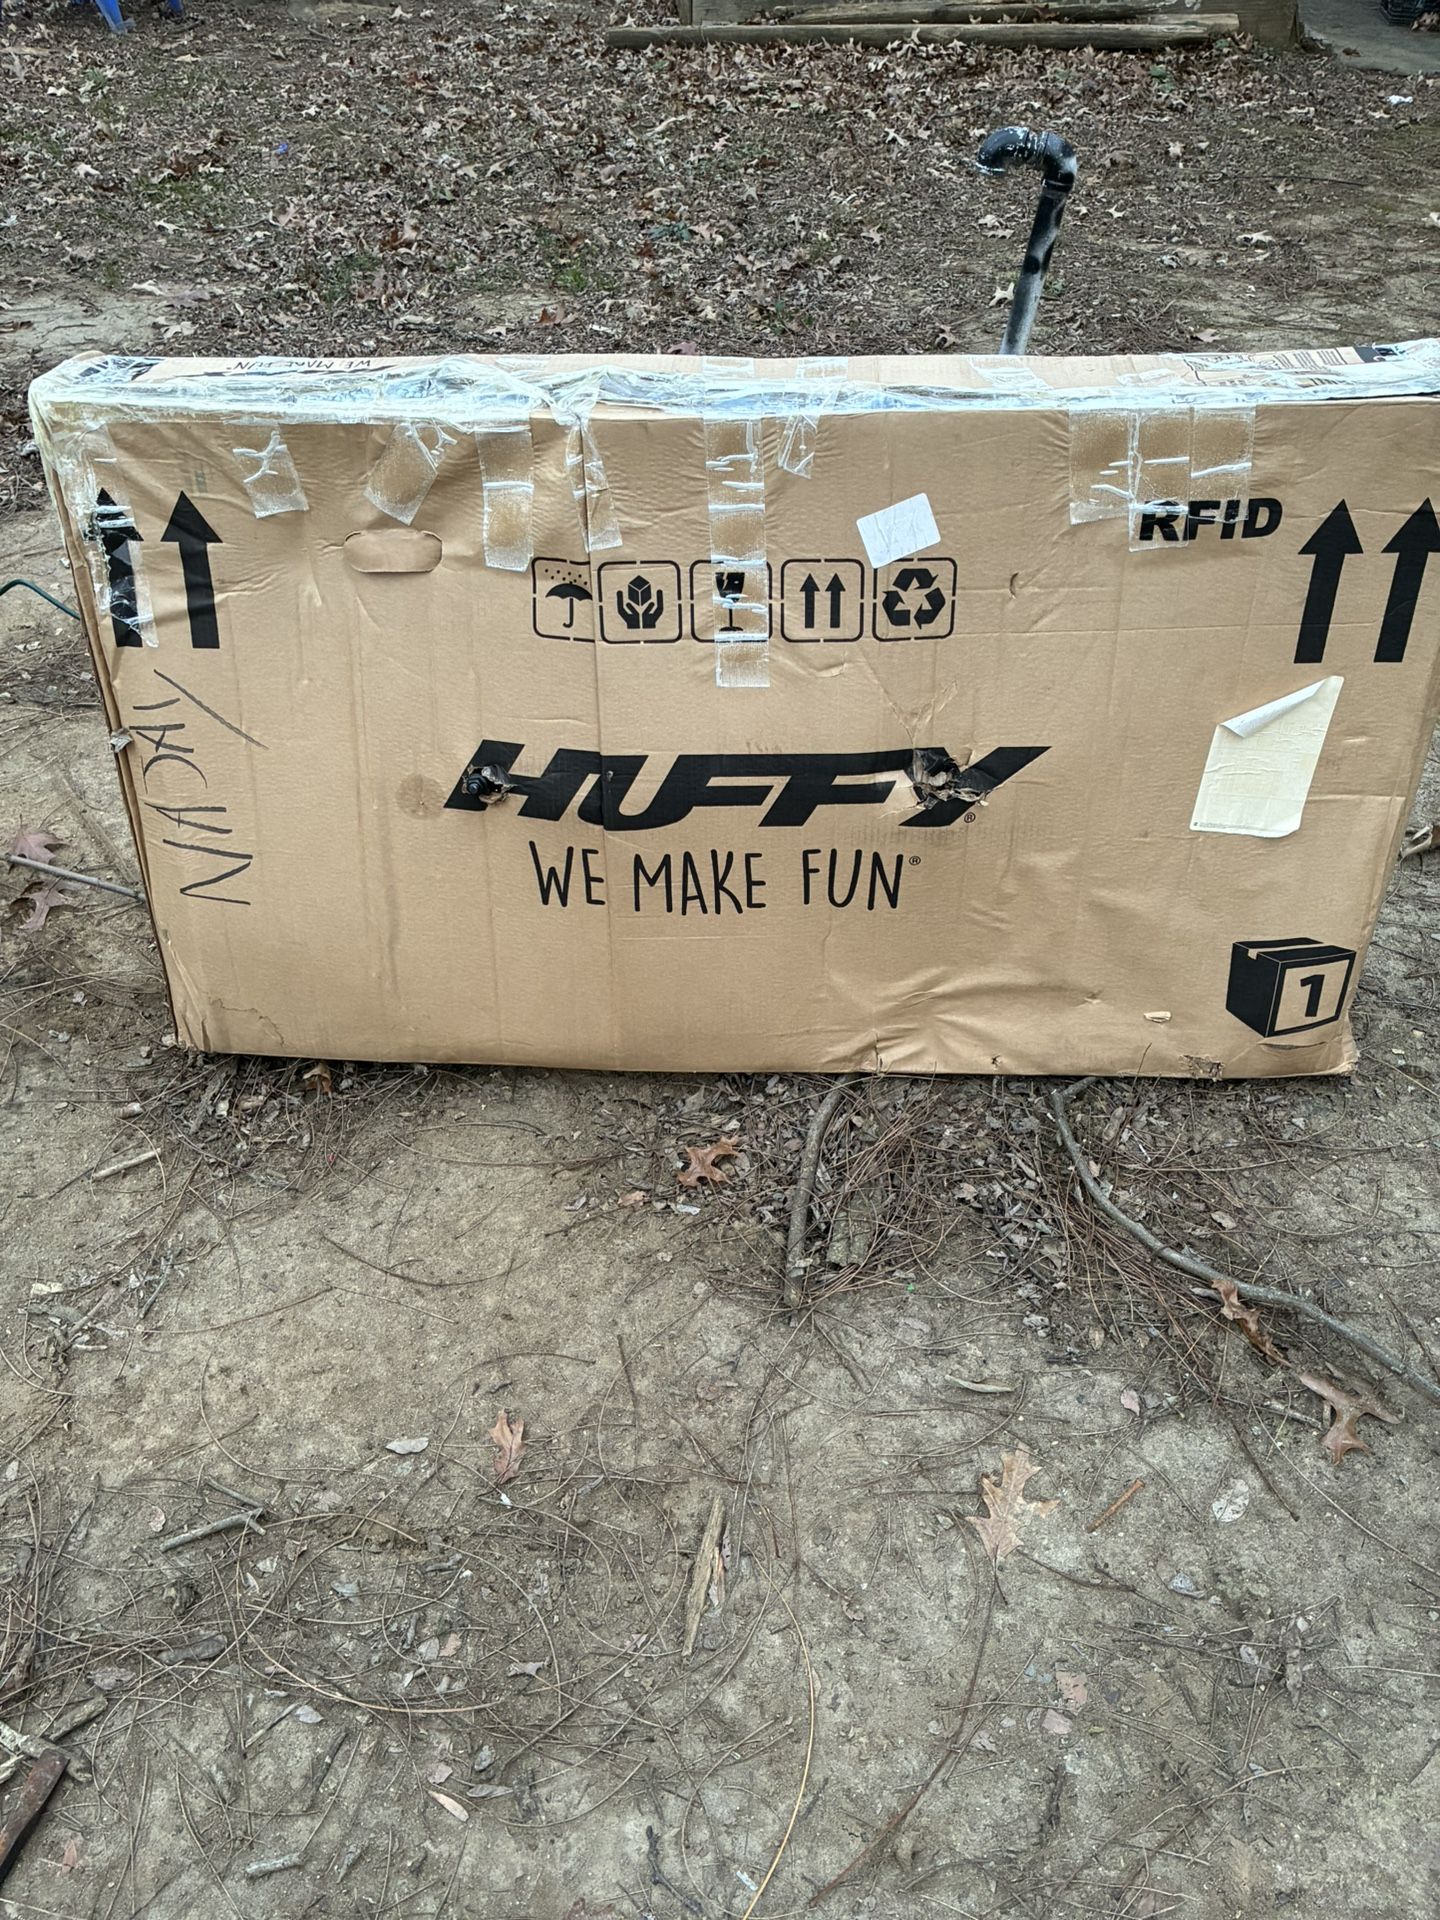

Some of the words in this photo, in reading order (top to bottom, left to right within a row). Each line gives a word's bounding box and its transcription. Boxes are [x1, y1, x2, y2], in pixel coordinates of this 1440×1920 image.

[1139, 498, 1283, 541] RFID
[529, 840, 606, 907] WE
[633, 849, 766, 915] MAKE
[1300, 974, 1325, 1017] 1
